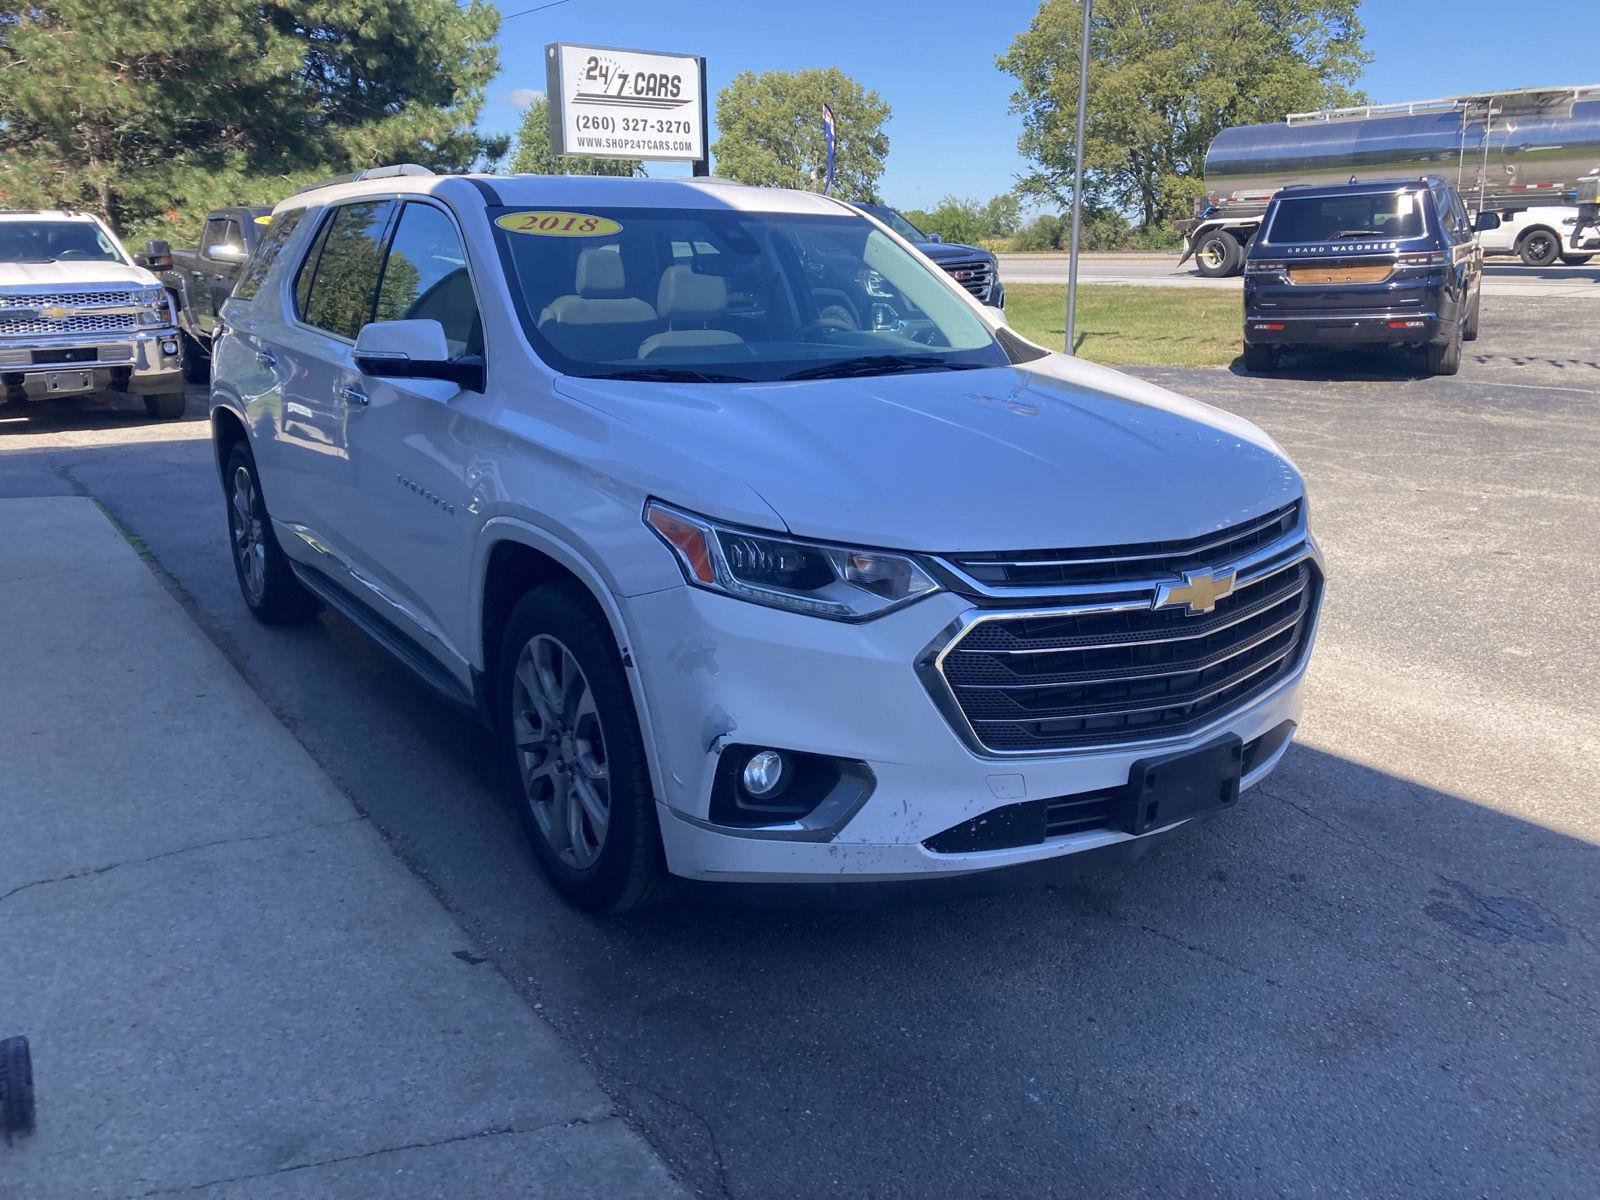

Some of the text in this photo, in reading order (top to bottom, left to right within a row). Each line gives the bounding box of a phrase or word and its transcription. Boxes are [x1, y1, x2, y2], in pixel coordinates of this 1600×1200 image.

[586, 56, 681, 98] 24/7 CARS
[576, 115, 690, 134] (260) 327-3270
[577, 136, 692, 151] WWW.SHOP247CARS.COM
[518, 216, 599, 231] 2018
[1287, 246, 1325, 254] GRAND
